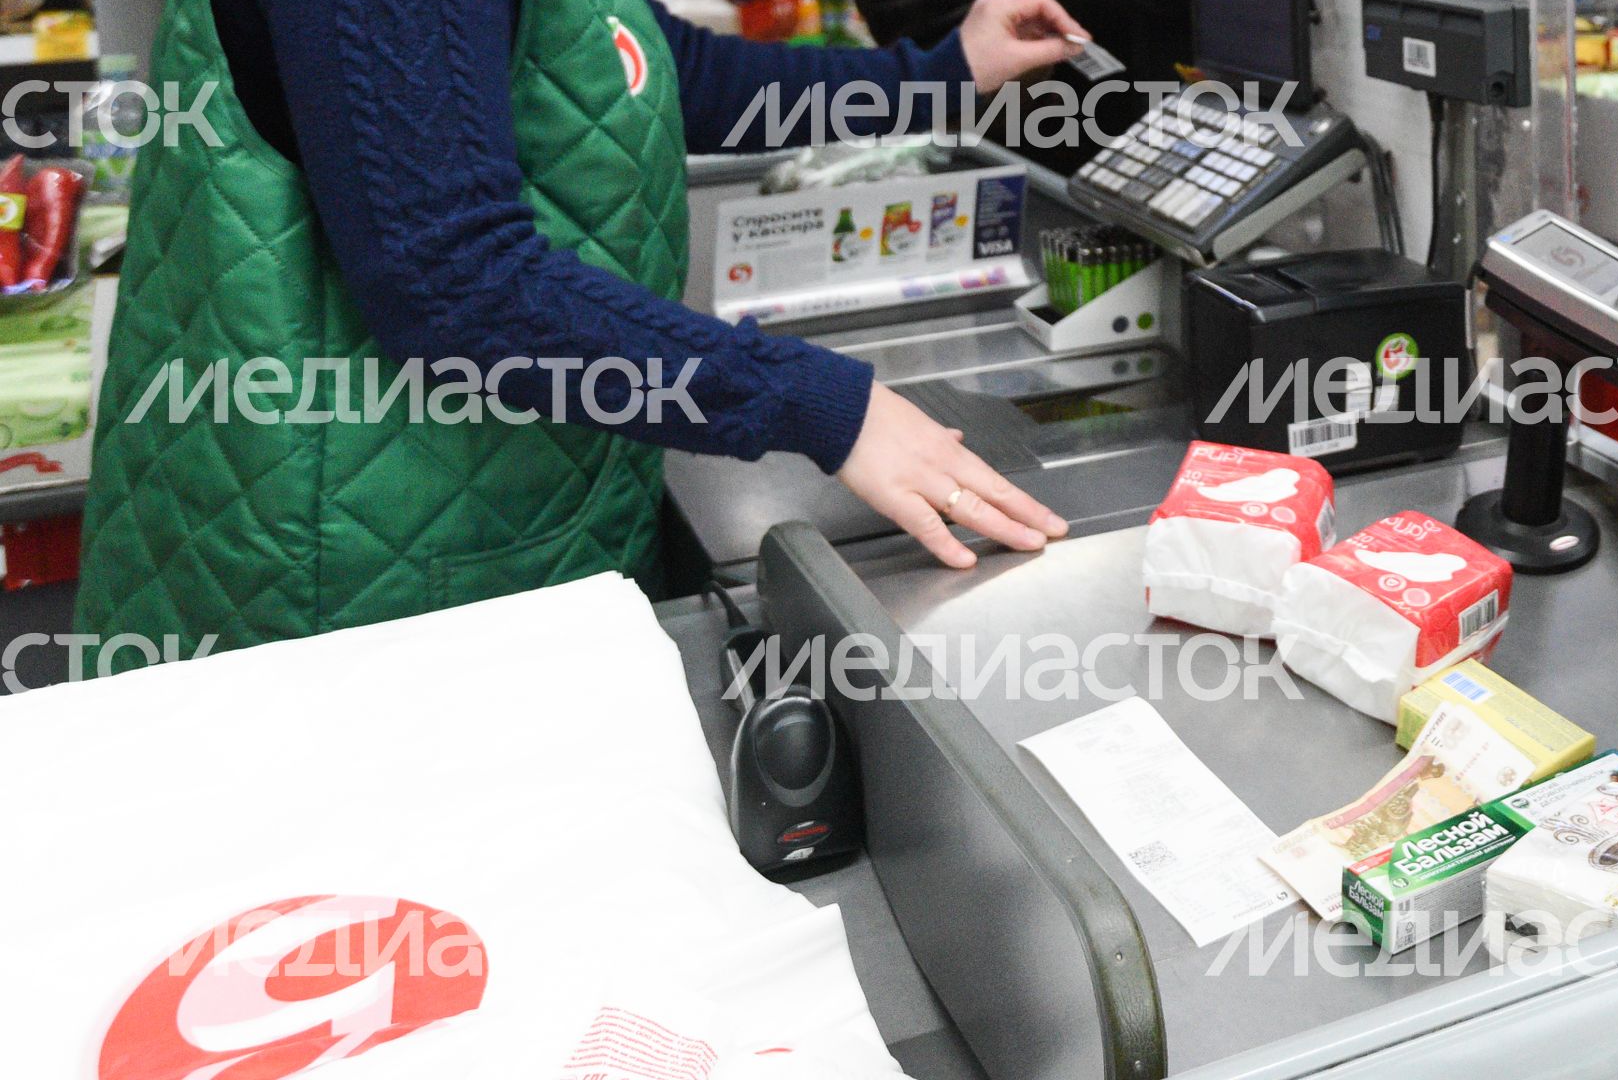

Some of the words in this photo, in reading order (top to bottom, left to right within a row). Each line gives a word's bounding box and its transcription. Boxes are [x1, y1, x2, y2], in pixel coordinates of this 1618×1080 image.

[732, 206, 824, 230] Спросите
[748, 220, 825, 240] кассира
[977, 238, 1014, 256] VISA
[1392, 822, 1510, 877] Бальзам
[1400, 811, 1495, 860] Лесной
[1348, 885, 1385, 921] Бальзам
[1353, 879, 1385, 909] Лесной
